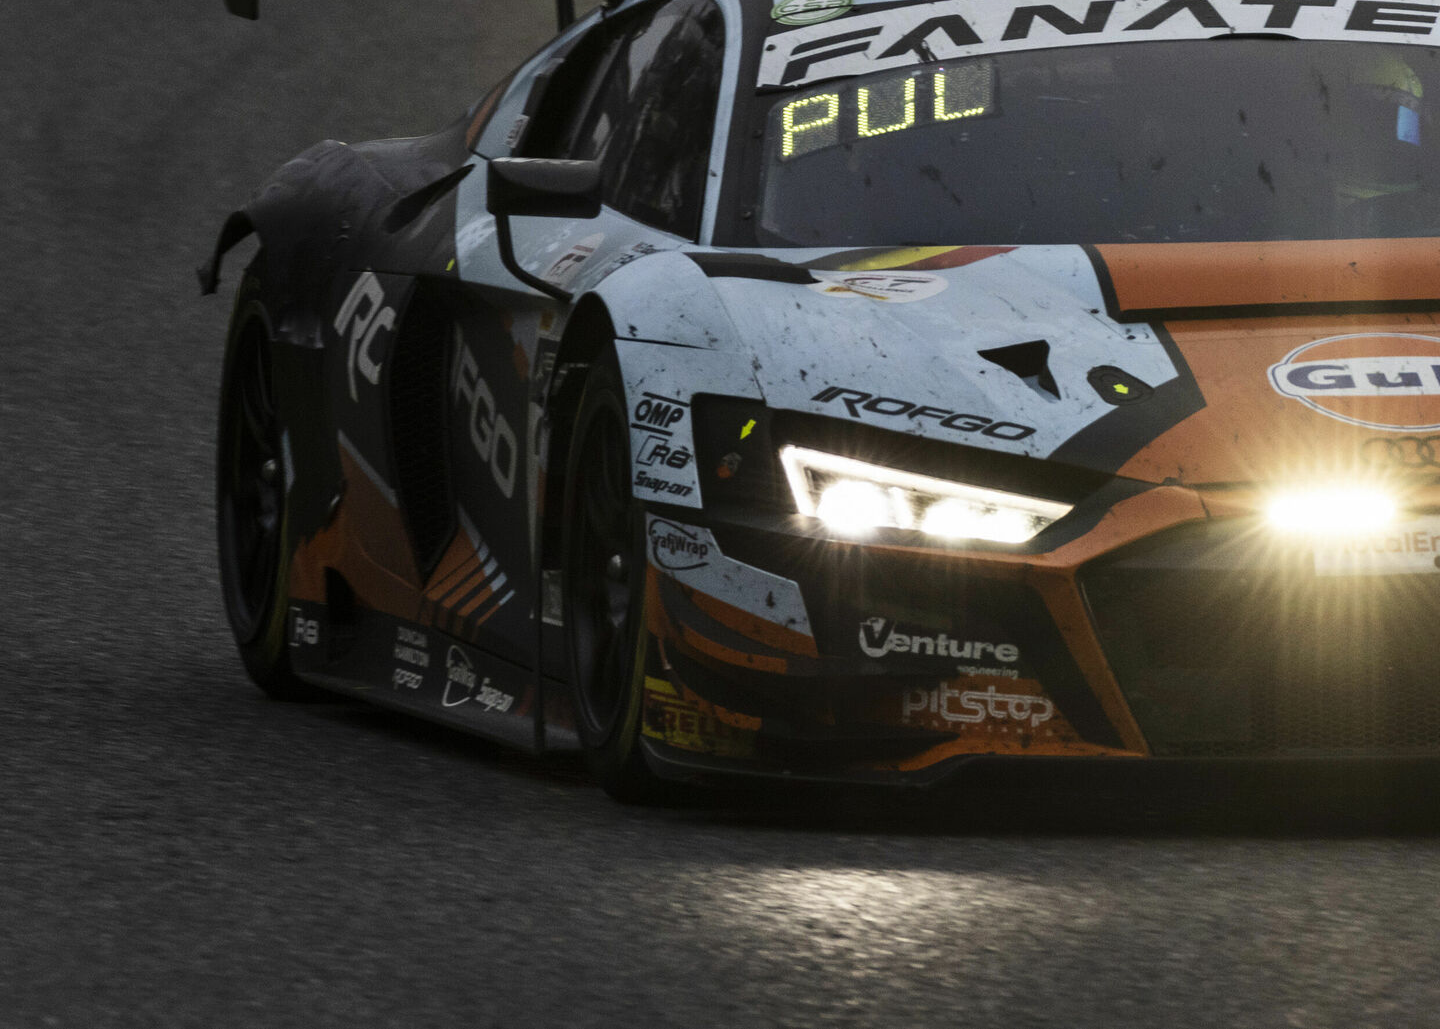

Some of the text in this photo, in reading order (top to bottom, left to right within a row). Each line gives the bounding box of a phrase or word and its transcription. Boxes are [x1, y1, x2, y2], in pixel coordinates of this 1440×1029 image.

[782, 73, 984, 156] PUL
[635, 399, 684, 428] OMP
[642, 439, 692, 469] R8
[634, 470, 693, 497] Snap-on
[859, 617, 1019, 662] Venture
[902, 680, 1054, 728] pitstop
